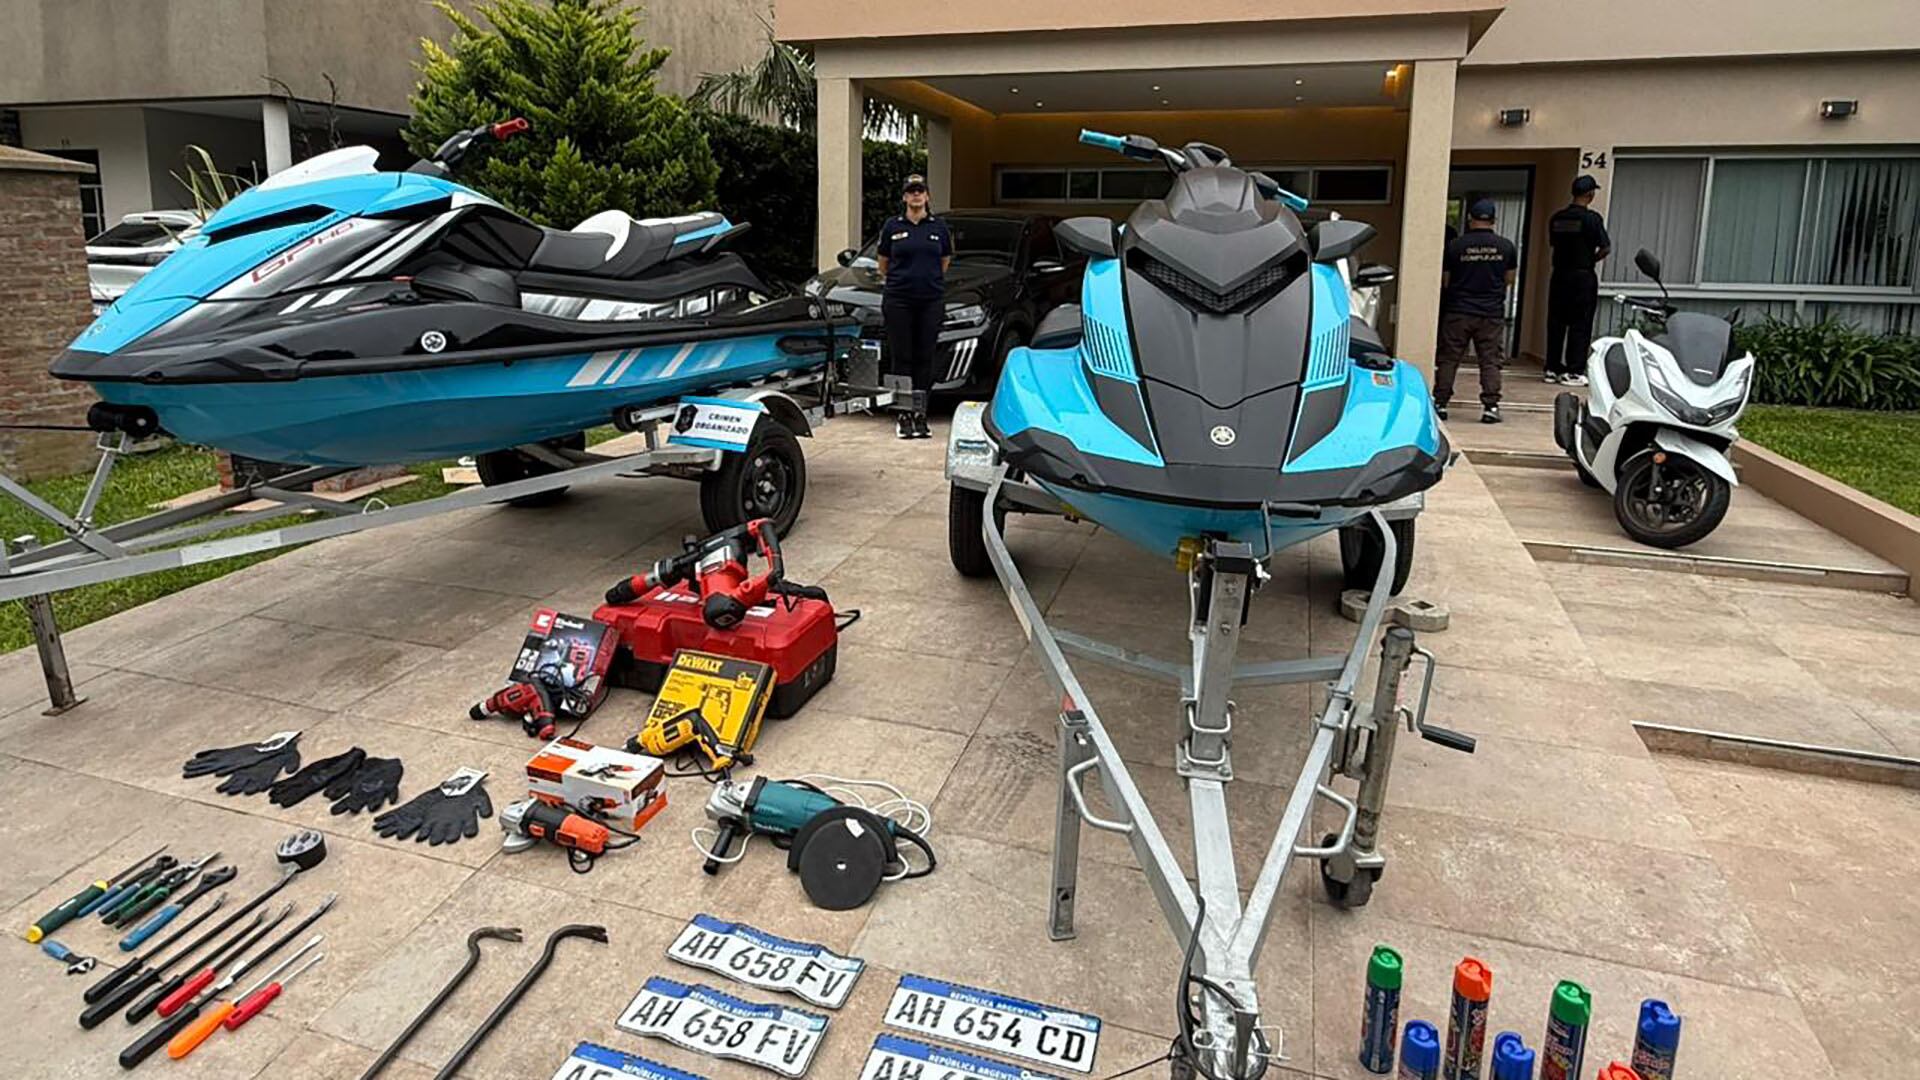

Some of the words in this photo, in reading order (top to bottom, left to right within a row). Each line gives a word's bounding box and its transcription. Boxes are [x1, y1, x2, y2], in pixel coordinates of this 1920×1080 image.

[1581, 152, 1607, 169] 54
[695, 421, 749, 435] ORGANIZADO
[708, 412, 742, 423] CRIMEN
[678, 931, 730, 960] AH
[728, 946, 796, 982] 658
[796, 960, 847, 998] FV
[950, 991, 994, 1009] REPÚBLICA
[996, 1003, 1044, 1020] ARGENTINA
[629, 996, 683, 1028] AH
[682, 1007, 752, 1048] 658
[754, 1023, 811, 1064] FV
[895, 993, 946, 1028] AH
[953, 1007, 1023, 1048] 654
[1036, 1025, 1085, 1063] CD
[873, 1056, 925, 1080] AH
[928, 1054, 975, 1073] REPÚBLICA
